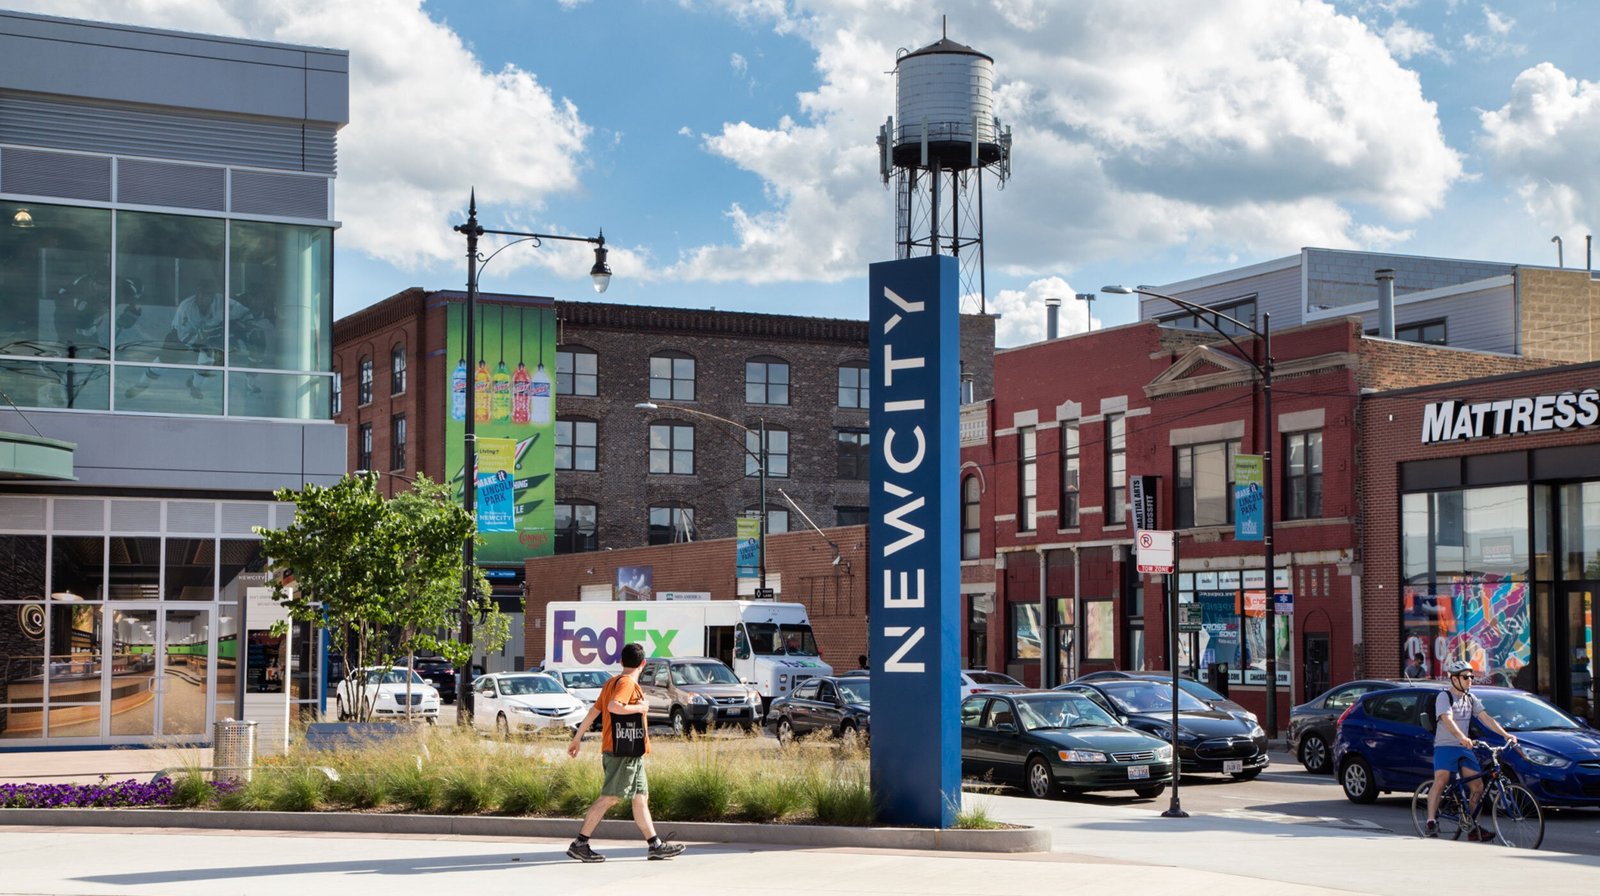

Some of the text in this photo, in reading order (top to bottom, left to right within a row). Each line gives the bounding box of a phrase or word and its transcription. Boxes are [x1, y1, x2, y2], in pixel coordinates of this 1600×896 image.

[1421, 388, 1599, 444] MATTRESS
[477, 471, 506, 488] MAKE it
[482, 480, 513, 497] LINCOLN
[883, 286, 926, 673] NEWCITY
[485, 493, 506, 506] PARK
[1135, 499, 1143, 529] MARTIAL
[553, 610, 679, 665] FedEx
[616, 722, 643, 741] BEATLES
